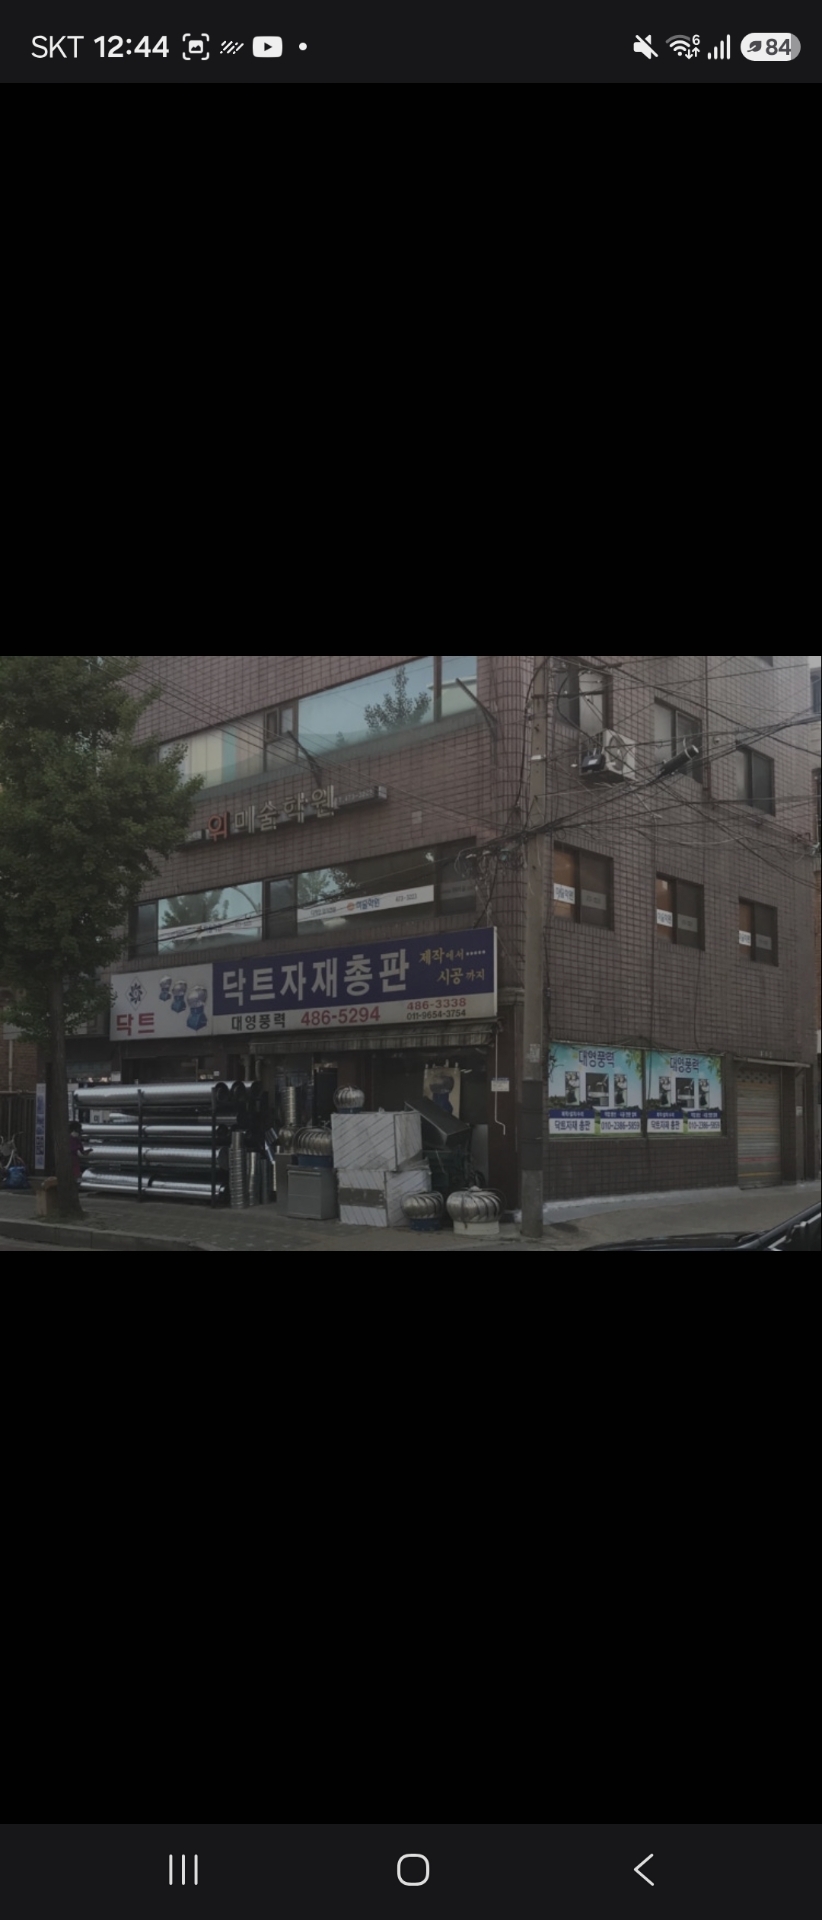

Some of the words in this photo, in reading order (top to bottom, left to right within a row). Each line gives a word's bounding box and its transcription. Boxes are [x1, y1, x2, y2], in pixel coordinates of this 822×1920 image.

[222, 948, 410, 1007] 닥트자재총판
[406, 997, 467, 1011] 486-3338
[231, 1012, 286, 1032] 대영풍력
[300, 1005, 381, 1027] 486-5294
[406, 1008, 467, 1021] 011-9654-3754
[116, 1012, 156, 1037] 닥트
[578, 1050, 615, 1069] 대영풍력
[669, 1057, 700, 1074] 대영풍력
